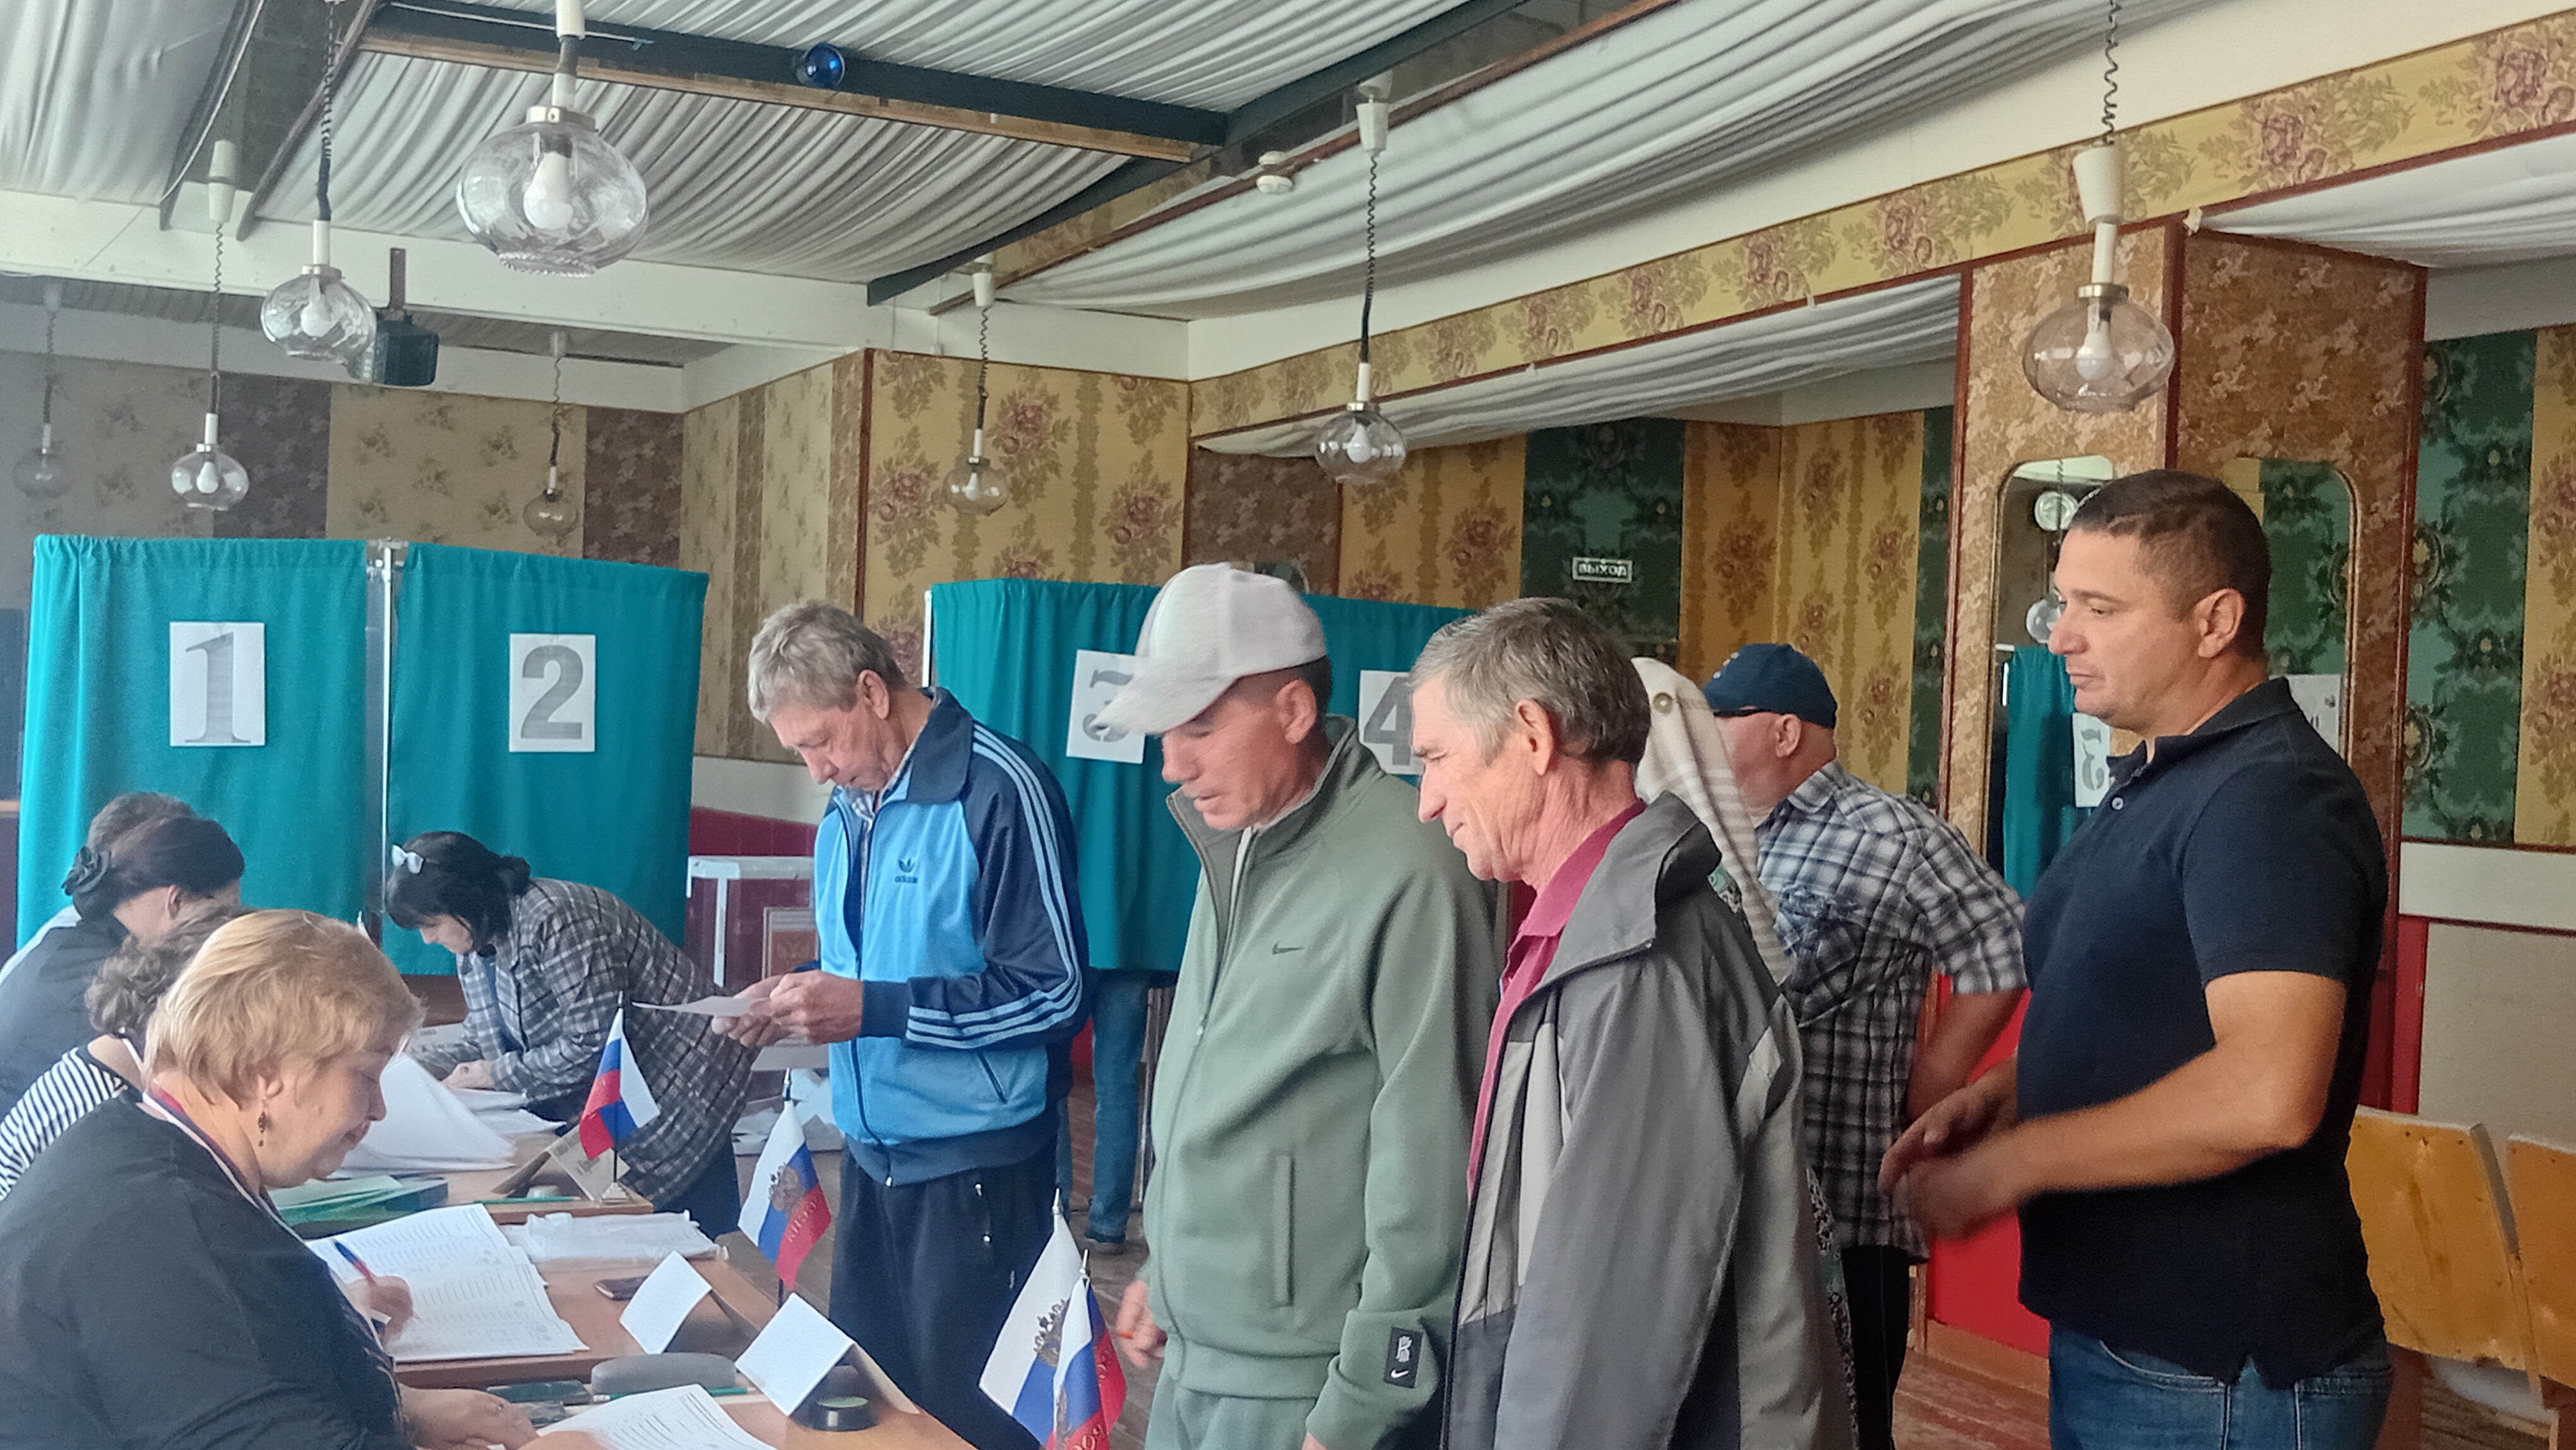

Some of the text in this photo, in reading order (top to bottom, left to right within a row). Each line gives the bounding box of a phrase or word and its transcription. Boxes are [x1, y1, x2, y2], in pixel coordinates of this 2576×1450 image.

[1578, 563, 1627, 577] ВЫХОД
[184, 632, 251, 743] 1
[520, 644, 584, 740] 2
[1364, 676, 1412, 766] 4
